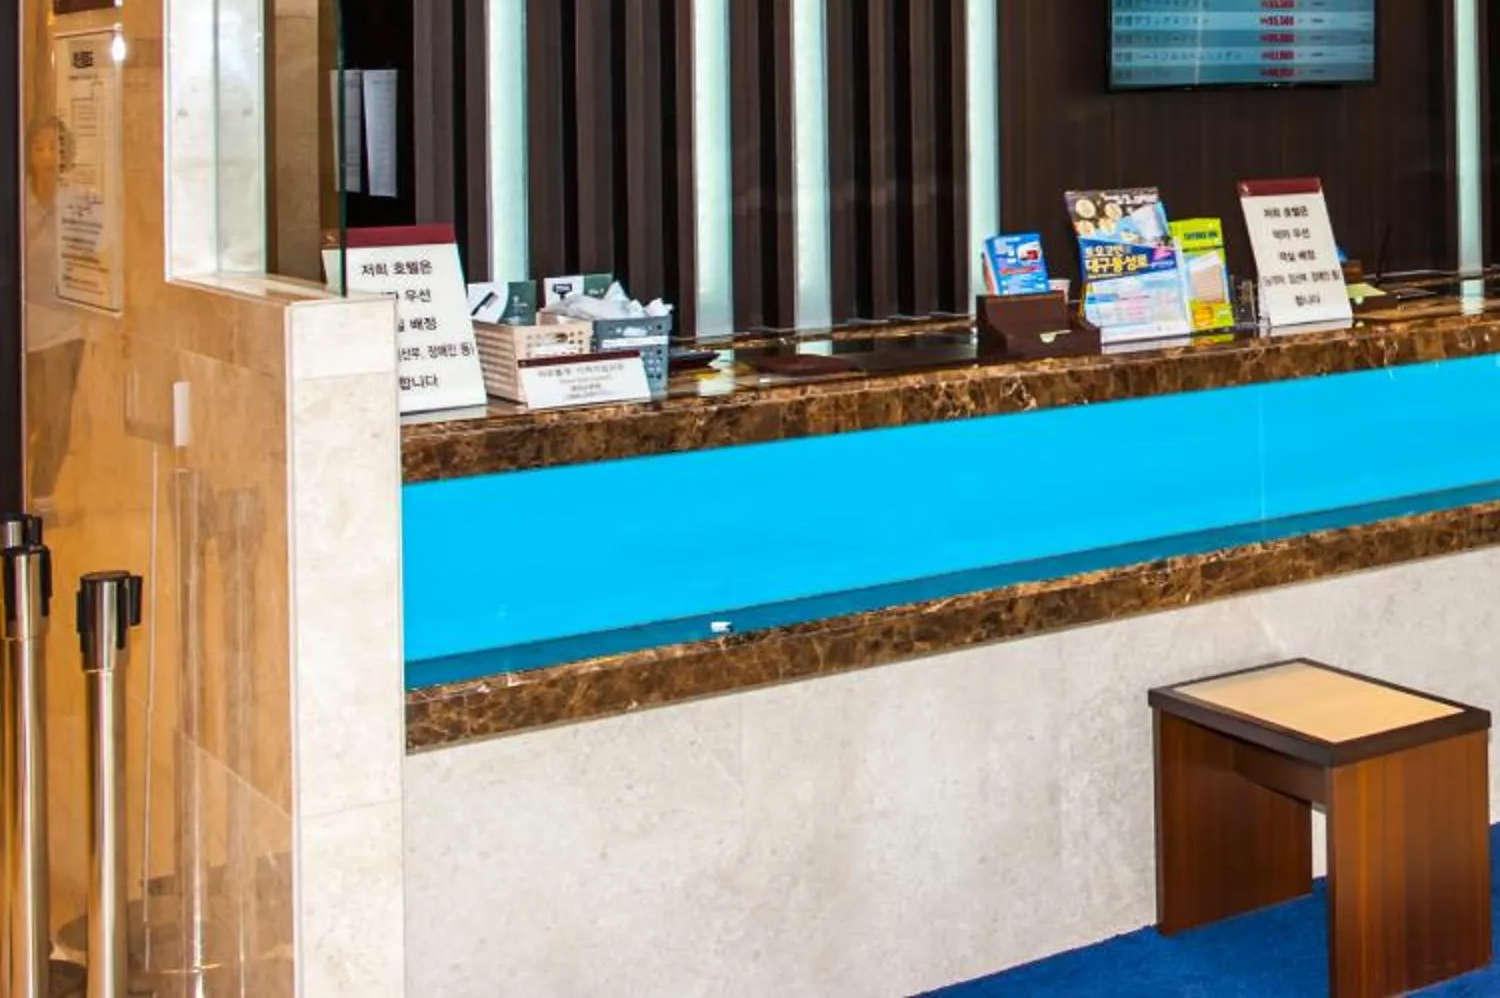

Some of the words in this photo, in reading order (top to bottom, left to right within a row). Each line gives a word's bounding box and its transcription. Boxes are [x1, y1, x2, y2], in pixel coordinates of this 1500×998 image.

[361, 263, 389, 277] 저희
[393, 259, 433, 276] 호텔은
[404, 288, 432, 303] 우선
[409, 316, 438, 331] 배정
[427, 343, 459, 359] 장애인
[399, 373, 440, 391] 합니다
